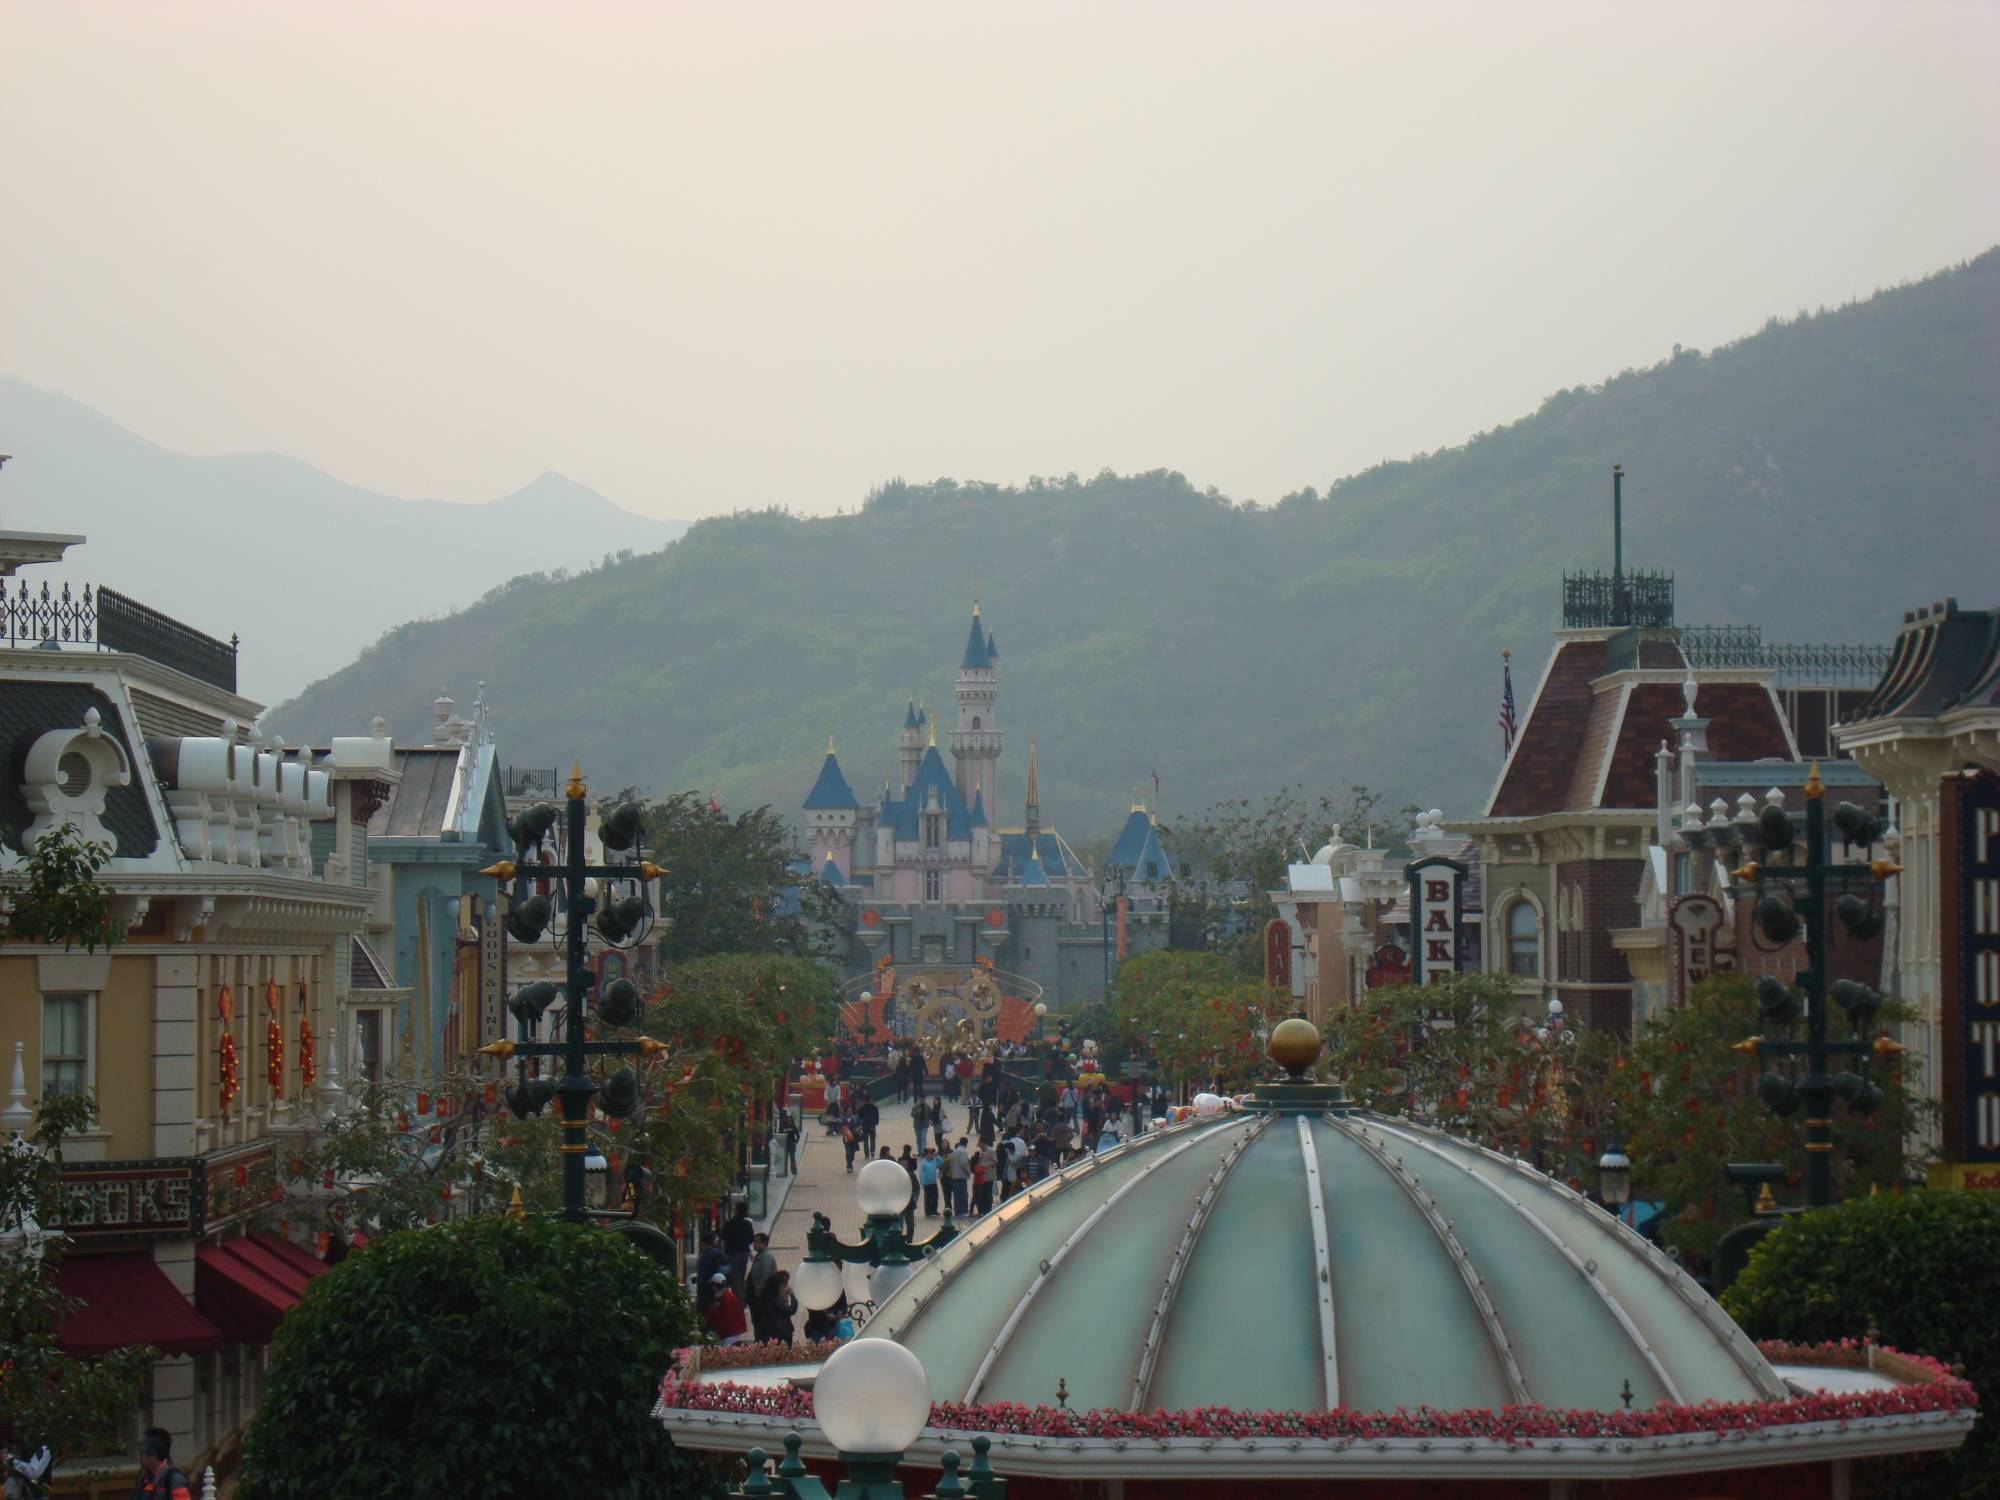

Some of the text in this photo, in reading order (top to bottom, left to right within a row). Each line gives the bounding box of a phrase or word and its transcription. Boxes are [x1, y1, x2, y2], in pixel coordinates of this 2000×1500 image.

[486, 977, 497, 987] &
[1971, 807, 2000, 1152] PHOTO
[486, 995, 497, 1036] FINE
